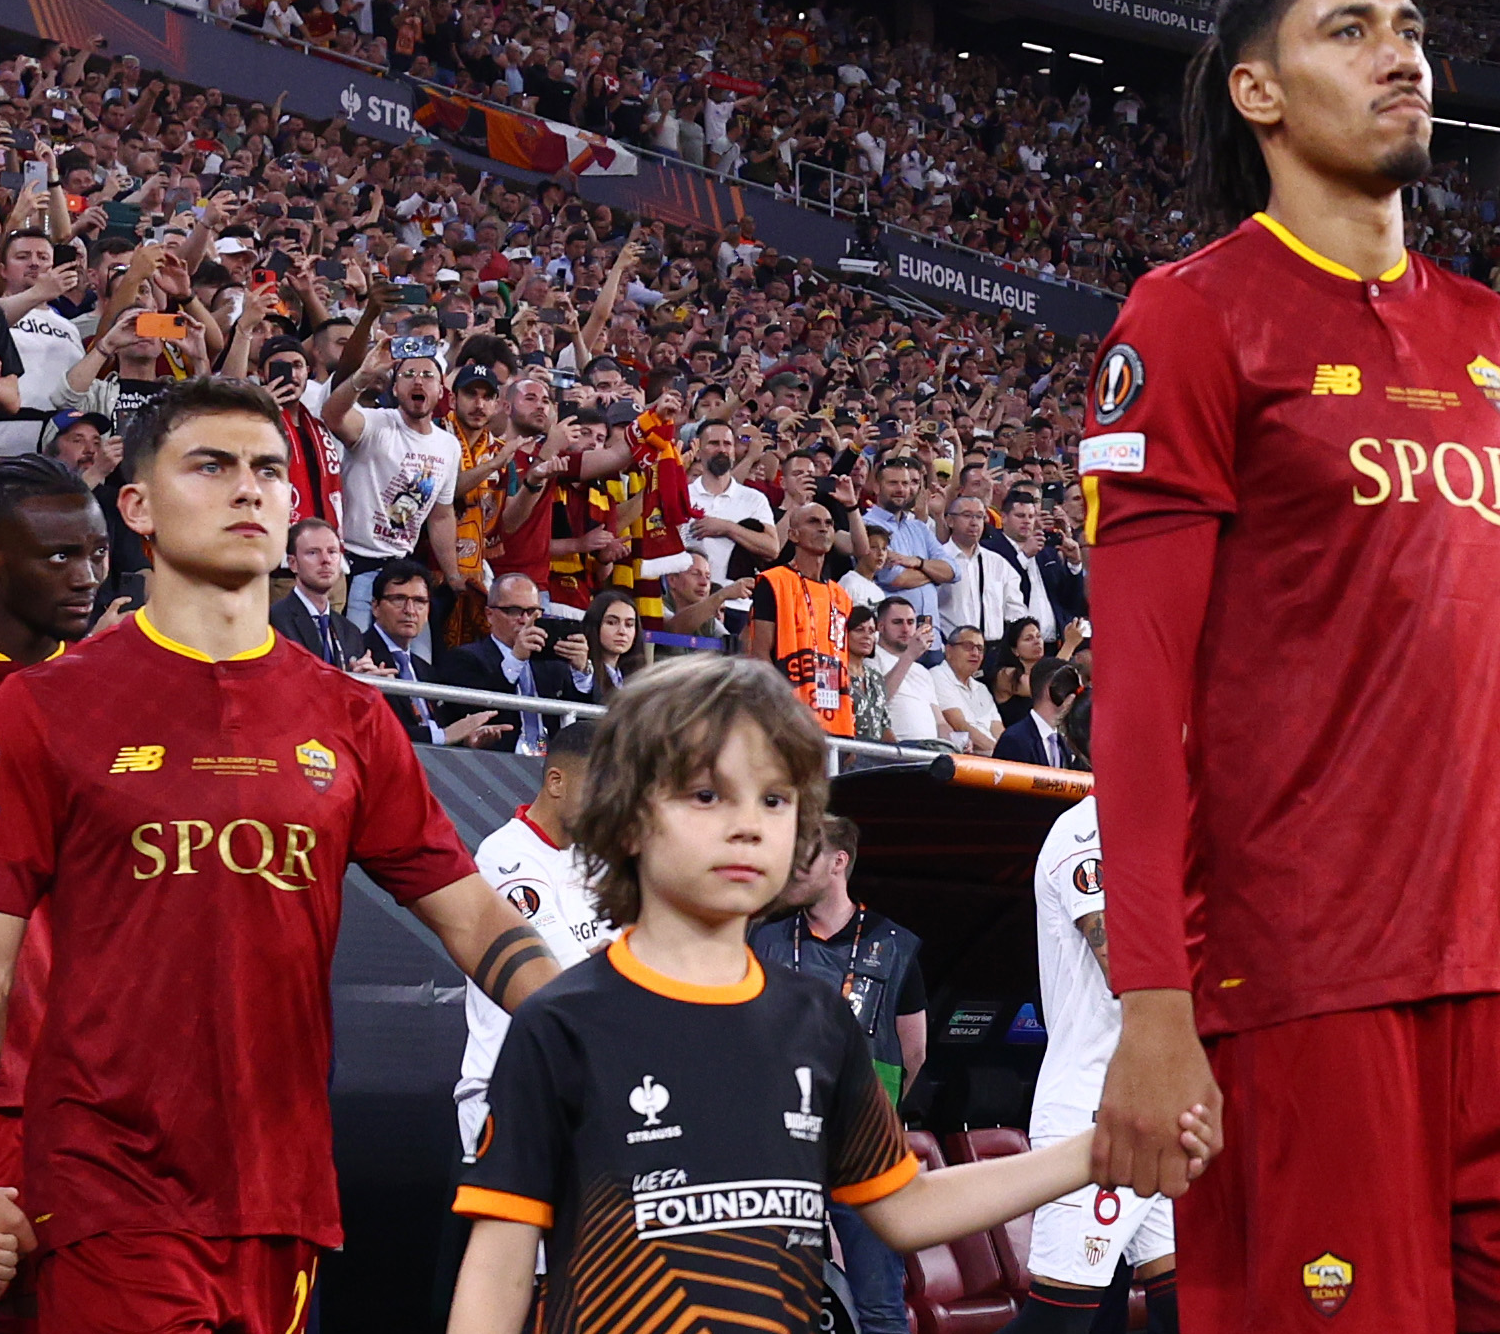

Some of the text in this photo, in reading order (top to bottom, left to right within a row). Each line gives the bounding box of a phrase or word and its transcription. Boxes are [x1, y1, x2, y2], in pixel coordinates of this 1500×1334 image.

[1133, 4, 1189, 29] EUROPA
[1190, 16, 1216, 36] LEA
[367, 95, 440, 141] STRA
[897, 253, 1038, 315] EUROPA LEAGUE
[130, 817, 318, 891] SPQR
[625, 1125, 683, 1145] STRAUSS
[630, 1166, 689, 1193] UEFA
[634, 1188, 826, 1232] FOUNDATION
[1094, 1186, 1121, 1227] 6
